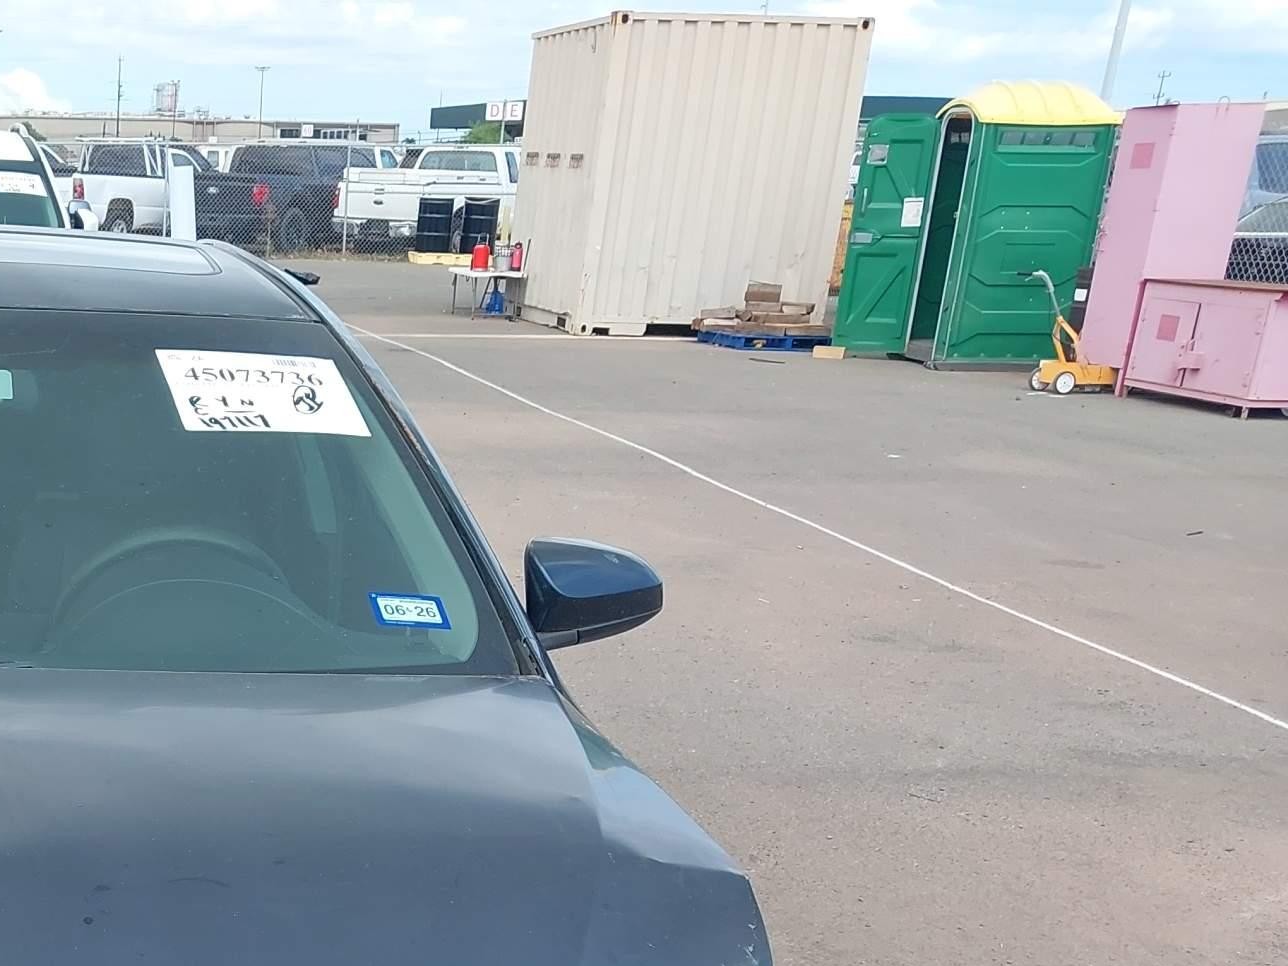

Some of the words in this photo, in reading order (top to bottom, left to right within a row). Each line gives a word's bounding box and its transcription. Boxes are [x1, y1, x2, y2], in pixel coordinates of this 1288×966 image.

[490, 104, 500, 118] D
[510, 104, 519, 118] E
[184, 367, 324, 386] 45073736
